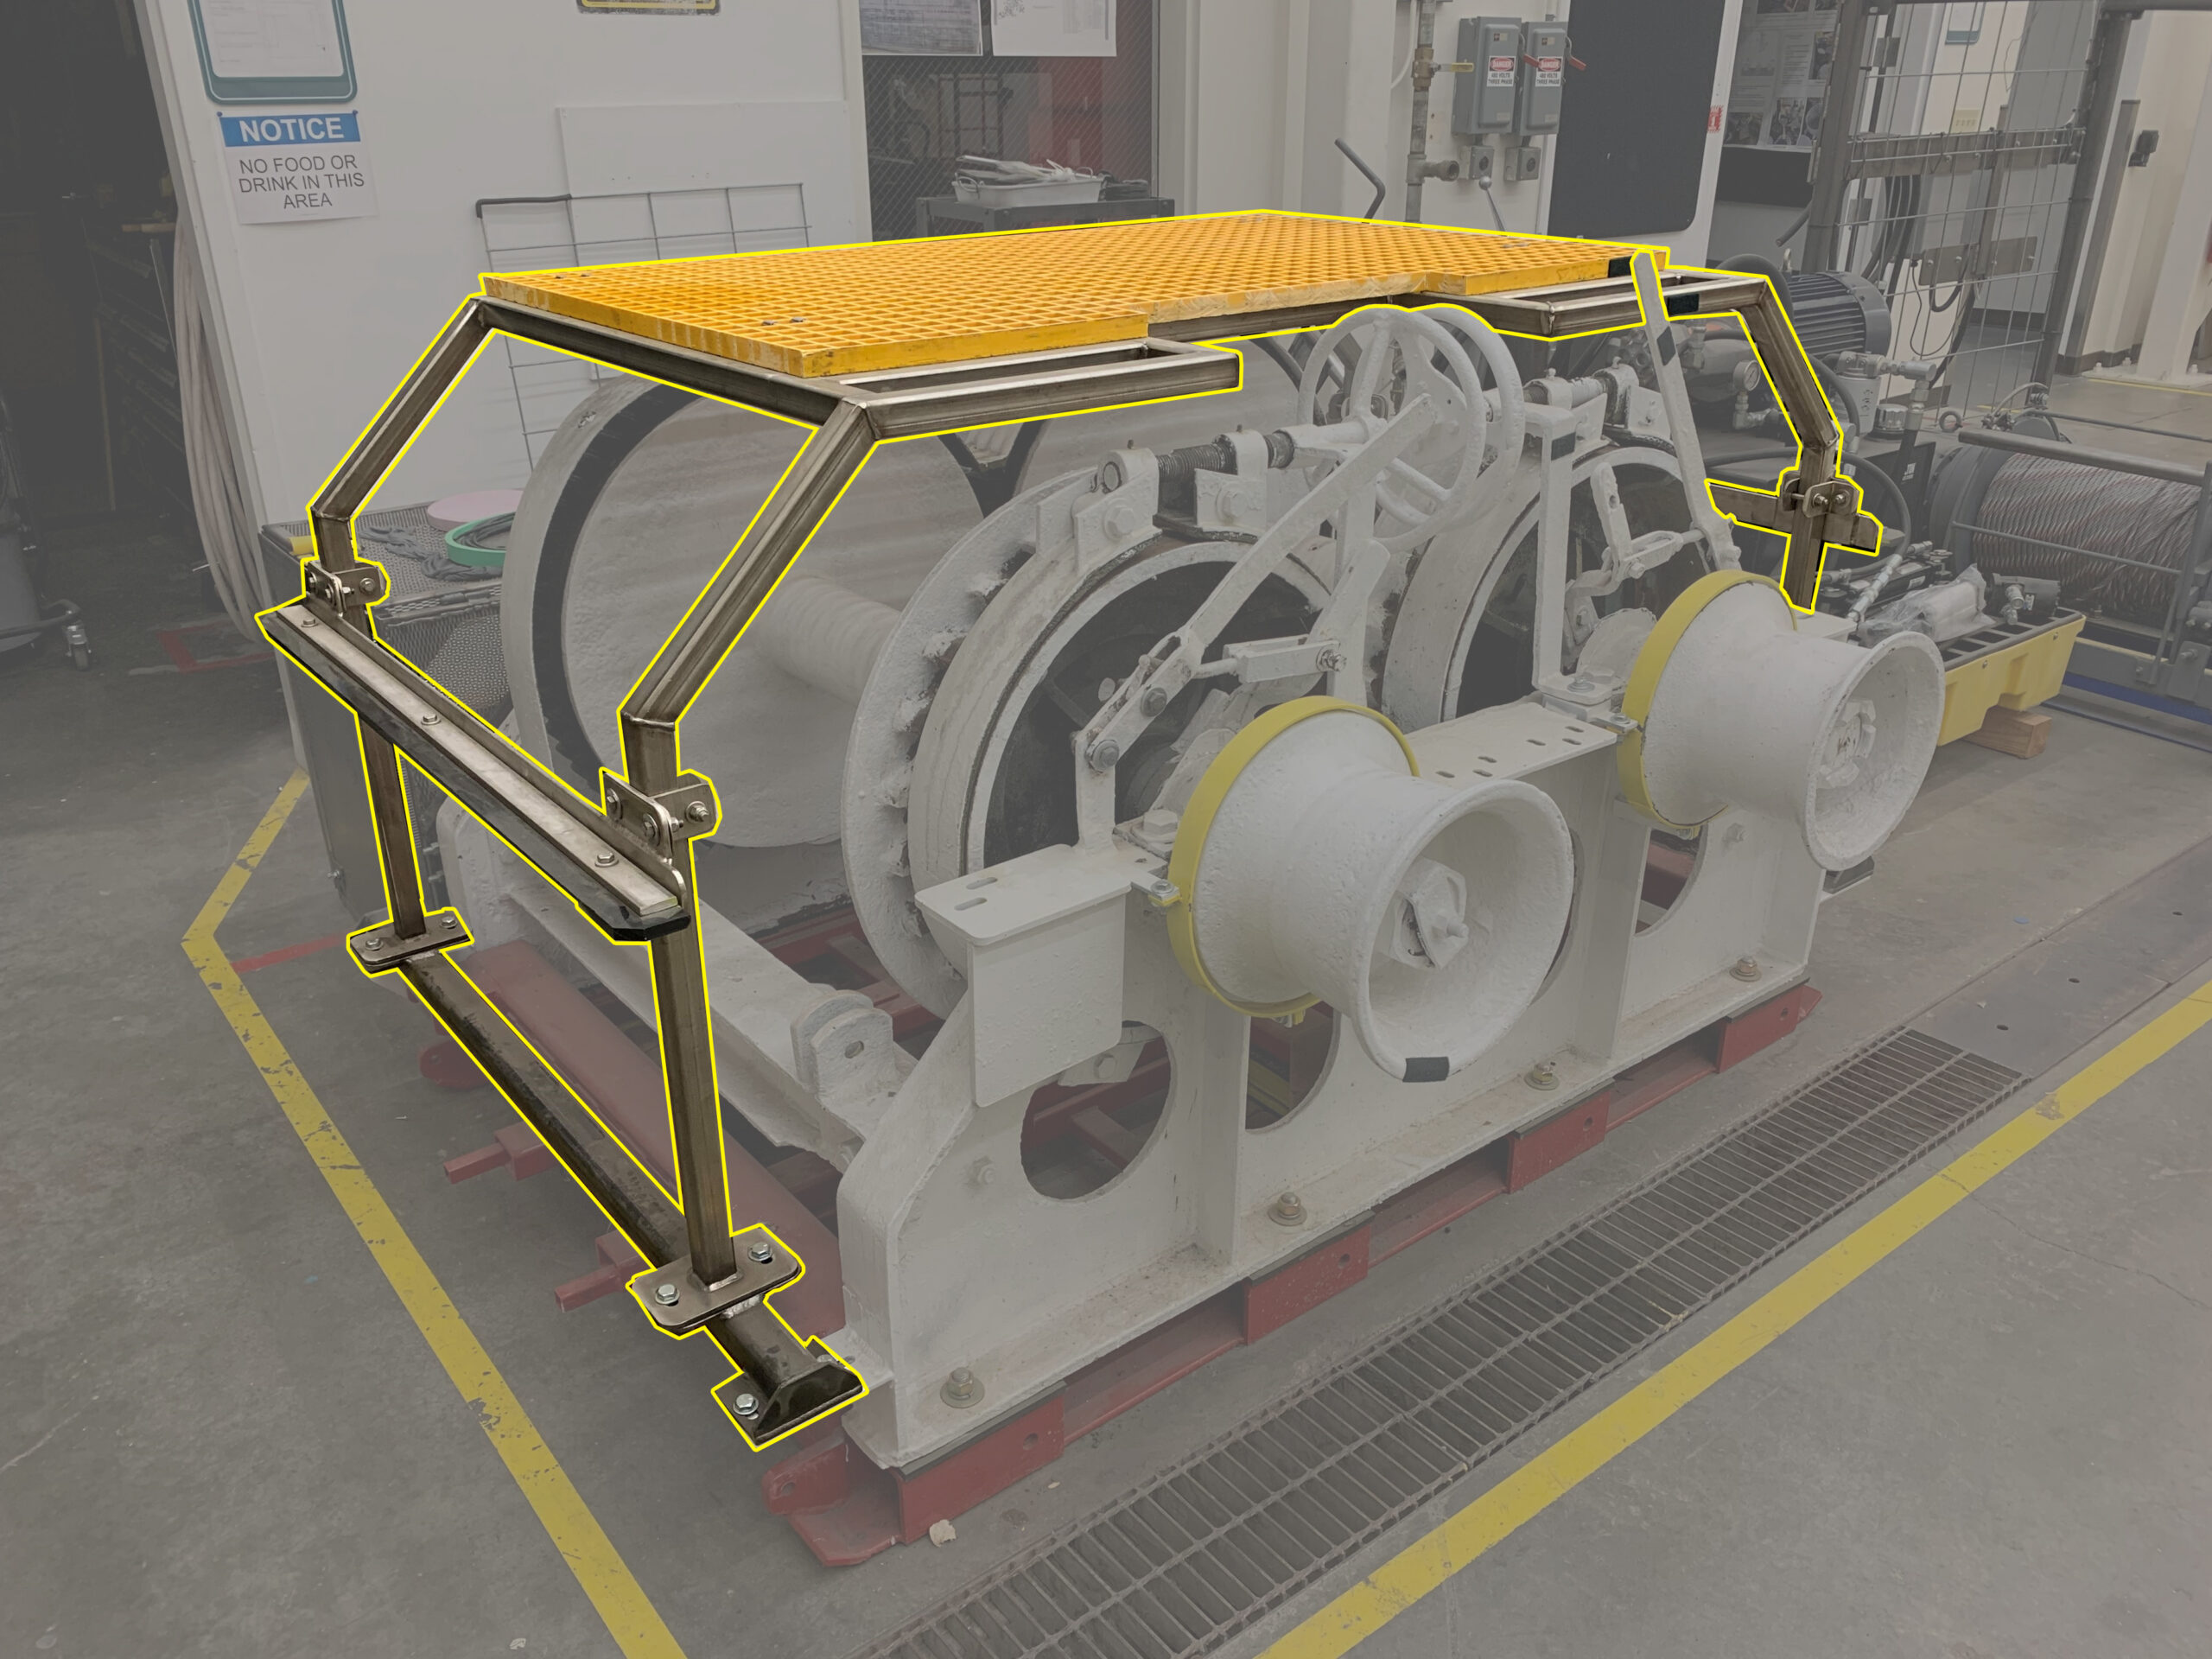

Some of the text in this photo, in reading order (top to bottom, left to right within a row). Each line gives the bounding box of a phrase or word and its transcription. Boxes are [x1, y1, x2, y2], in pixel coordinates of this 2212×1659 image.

[239, 118, 345, 143] NOTICE
[239, 155, 358, 174] NO FOOD OR
[238, 173, 365, 193] DRINK IN THIS
[283, 193, 333, 209] AREA
